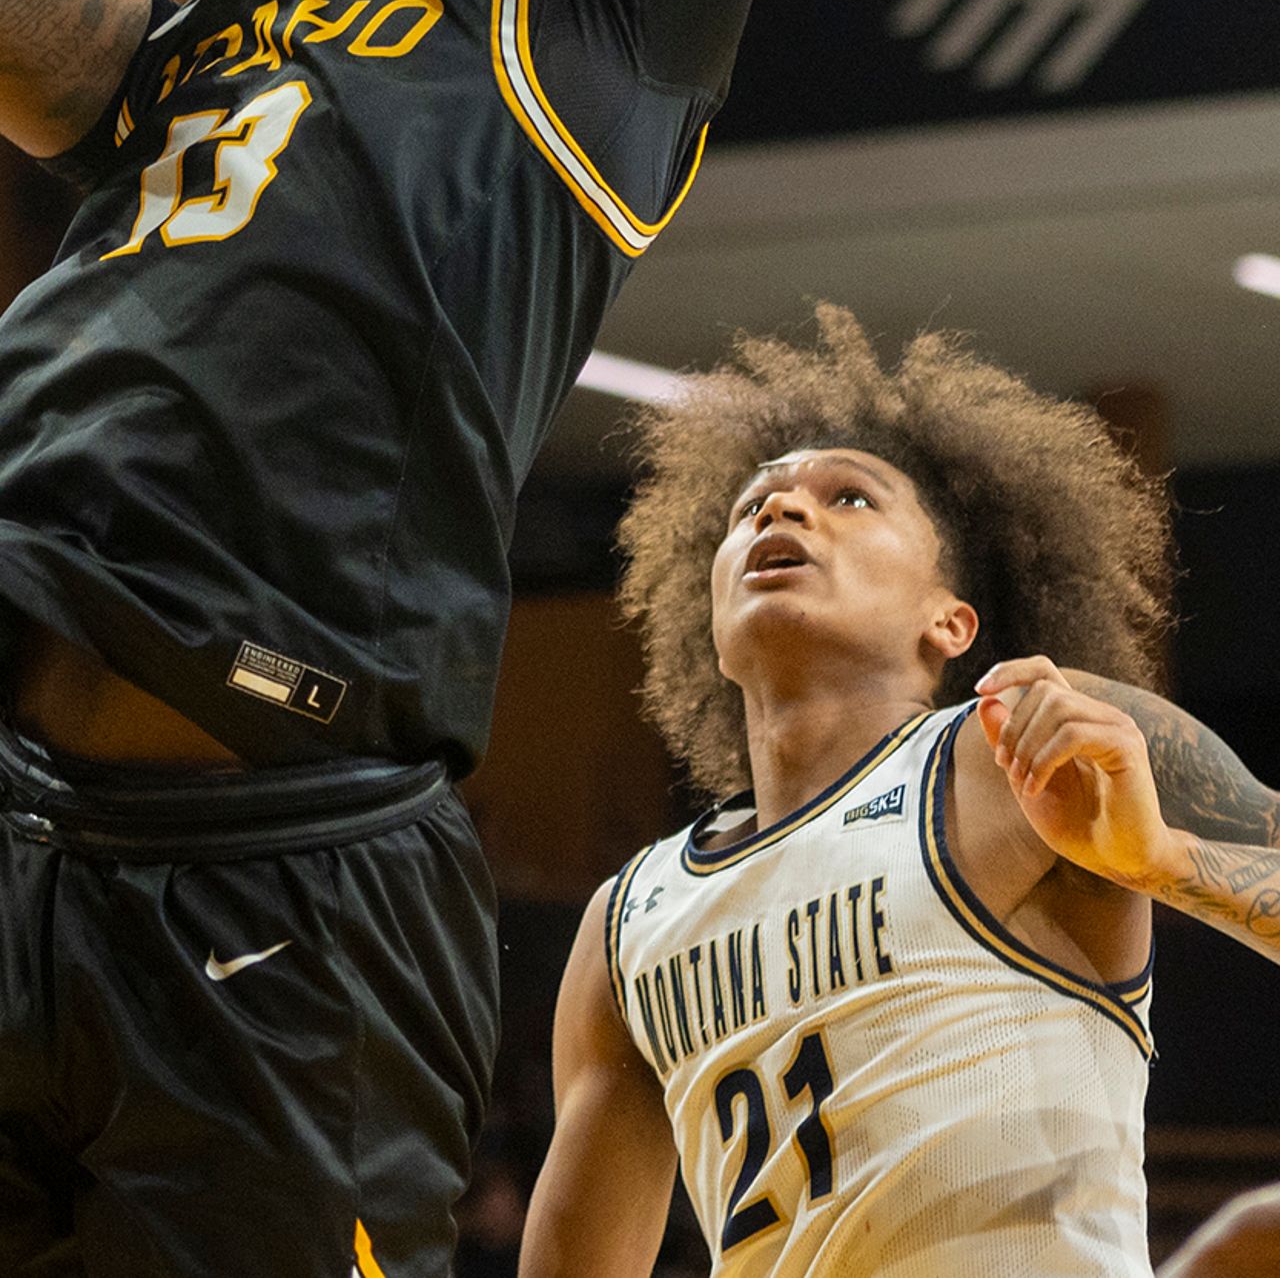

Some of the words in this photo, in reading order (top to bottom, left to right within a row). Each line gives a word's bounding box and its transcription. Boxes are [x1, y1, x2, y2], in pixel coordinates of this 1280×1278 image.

[99, 80, 313, 261] 13
[307, 685, 321, 709] L
[634, 924, 767, 1077] MONTANA
[784, 875, 896, 1009] STATE
[712, 1021, 840, 1253] 21
